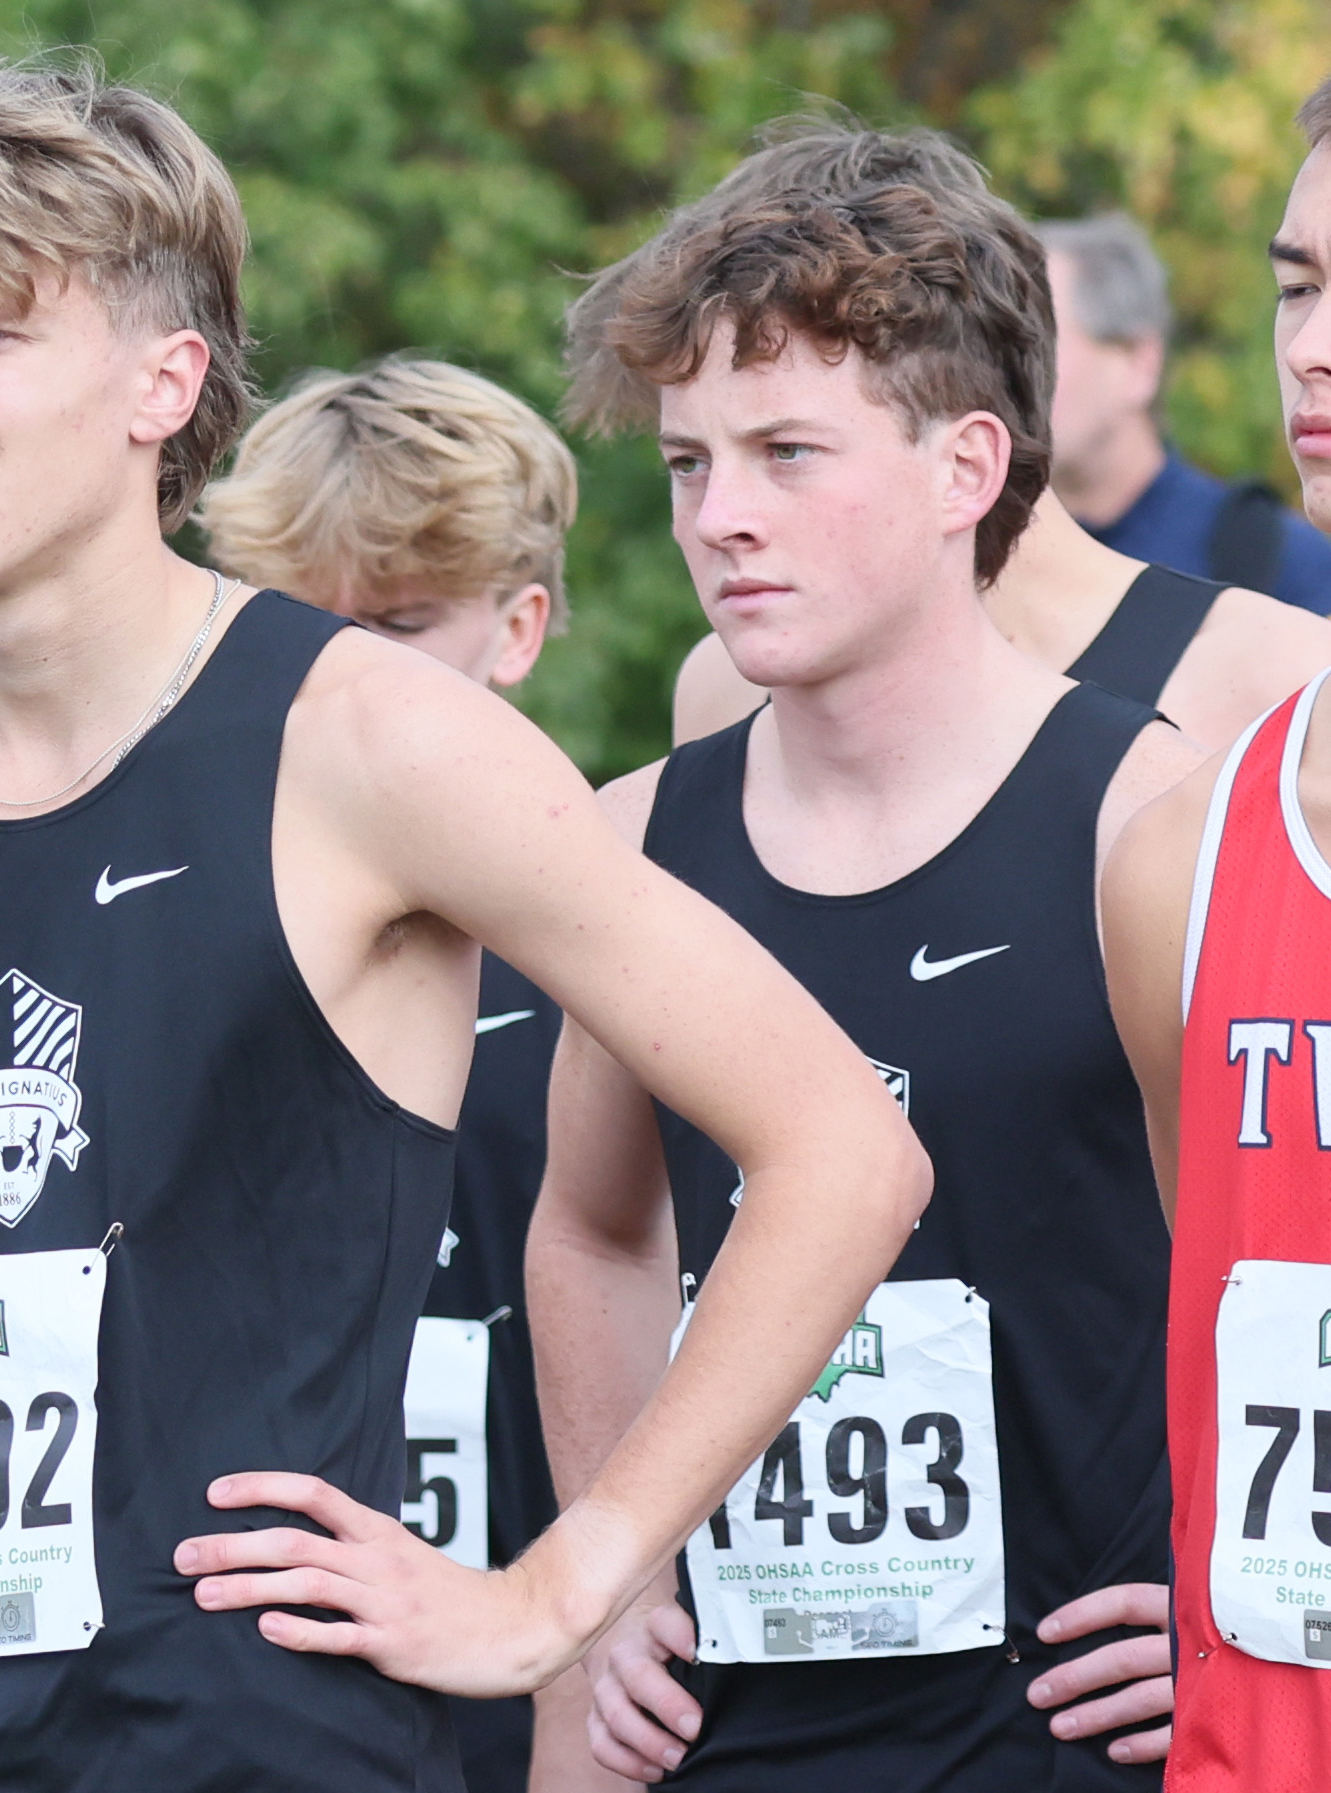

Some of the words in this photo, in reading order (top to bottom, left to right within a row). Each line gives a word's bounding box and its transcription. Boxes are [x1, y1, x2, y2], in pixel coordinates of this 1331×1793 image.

[1, 1081, 68, 1107] IGNATIUS
[3, 1181, 15, 1190] EST
[402, 1438, 457, 1547] 5
[8, 1545, 73, 1564] Country
[718, 1564, 752, 1580] 2025
[756, 1562, 814, 1580] OHSAA
[821, 1560, 880, 1576] Cross
[888, 1555, 976, 1574] Country
[1240, 1556, 1288, 1576] 2025
[749, 1588, 788, 1604] State
[792, 1581, 934, 1603] Championship
[1275, 1586, 1326, 1607] State
[8, 1633, 32, 1642] TIMING
